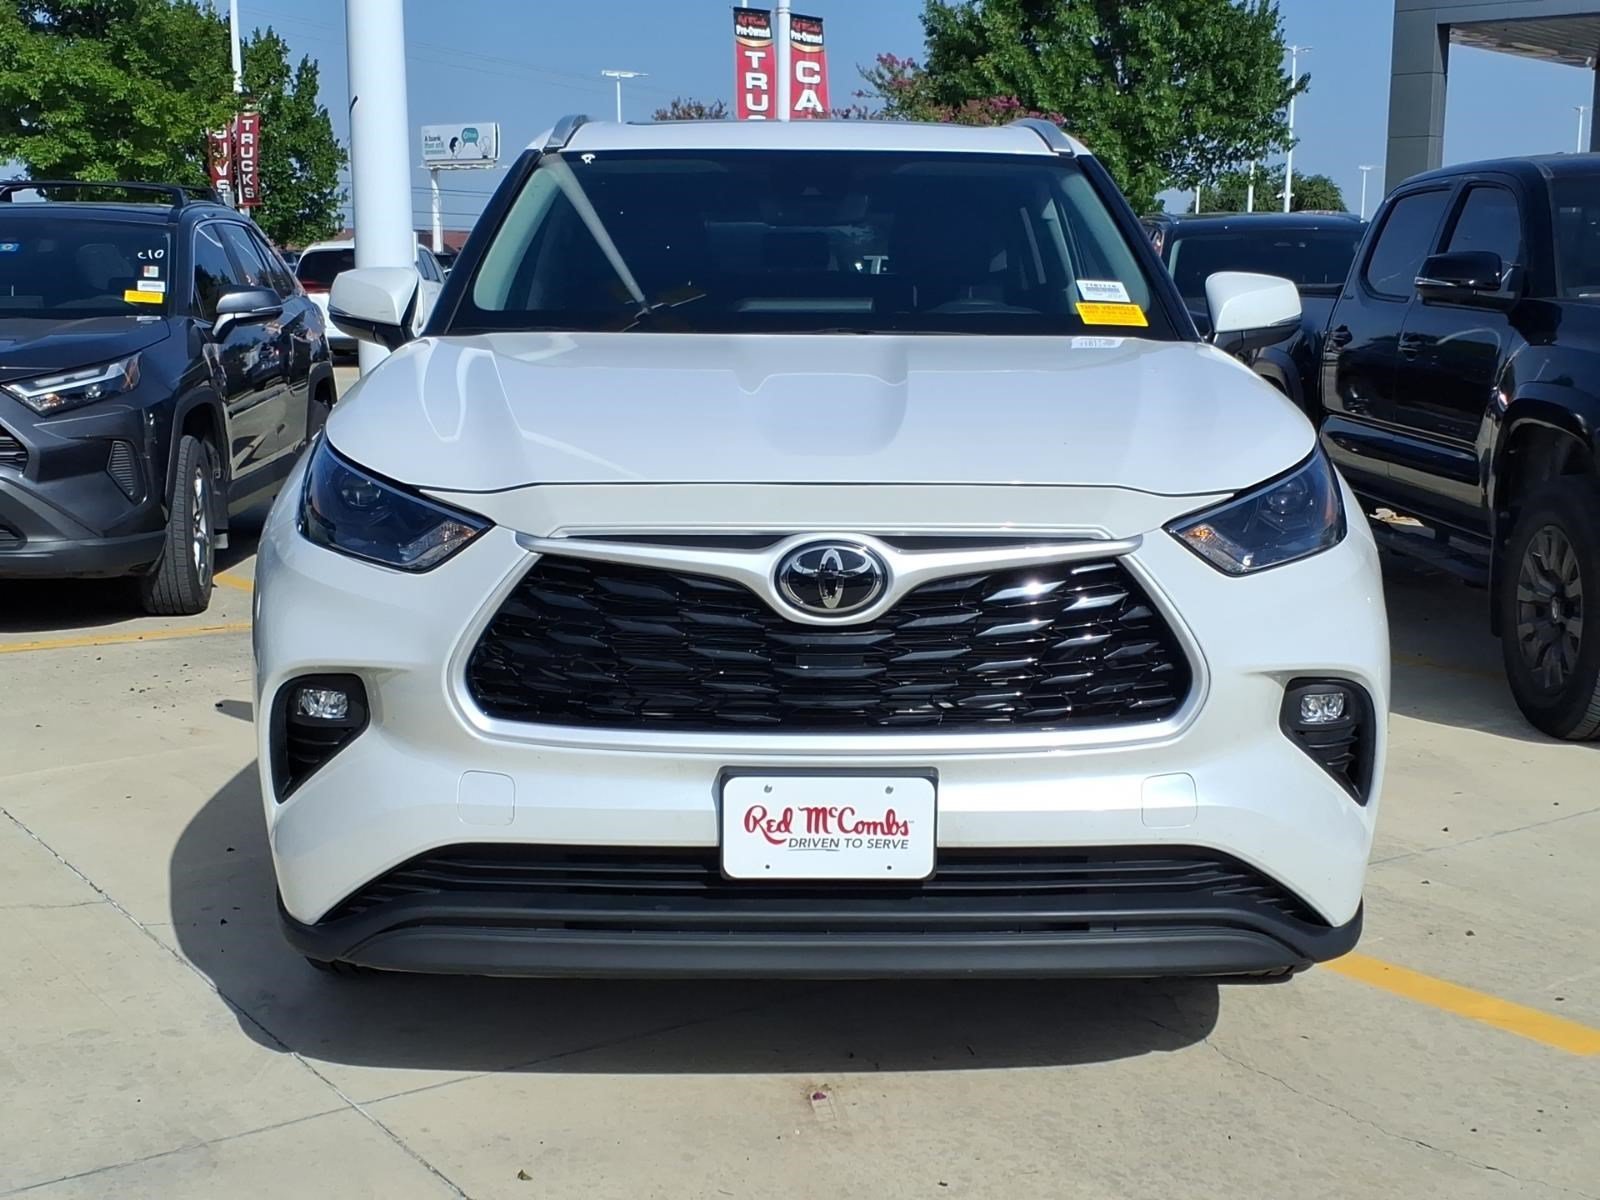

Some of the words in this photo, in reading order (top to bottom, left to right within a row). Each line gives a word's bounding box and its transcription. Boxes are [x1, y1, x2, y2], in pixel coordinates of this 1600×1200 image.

[735, 25, 771, 37] Pre-Owned
[790, 30, 823, 43] Pre-Owned
[744, 50, 769, 120] TRU
[240, 119, 255, 198] TRUCKS
[744, 805, 793, 845] Red
[798, 806, 910, 837] McCombs
[788, 838, 840, 848] DRIVEN
[844, 838, 863, 849] TO
[867, 838, 909, 850] SERVE
